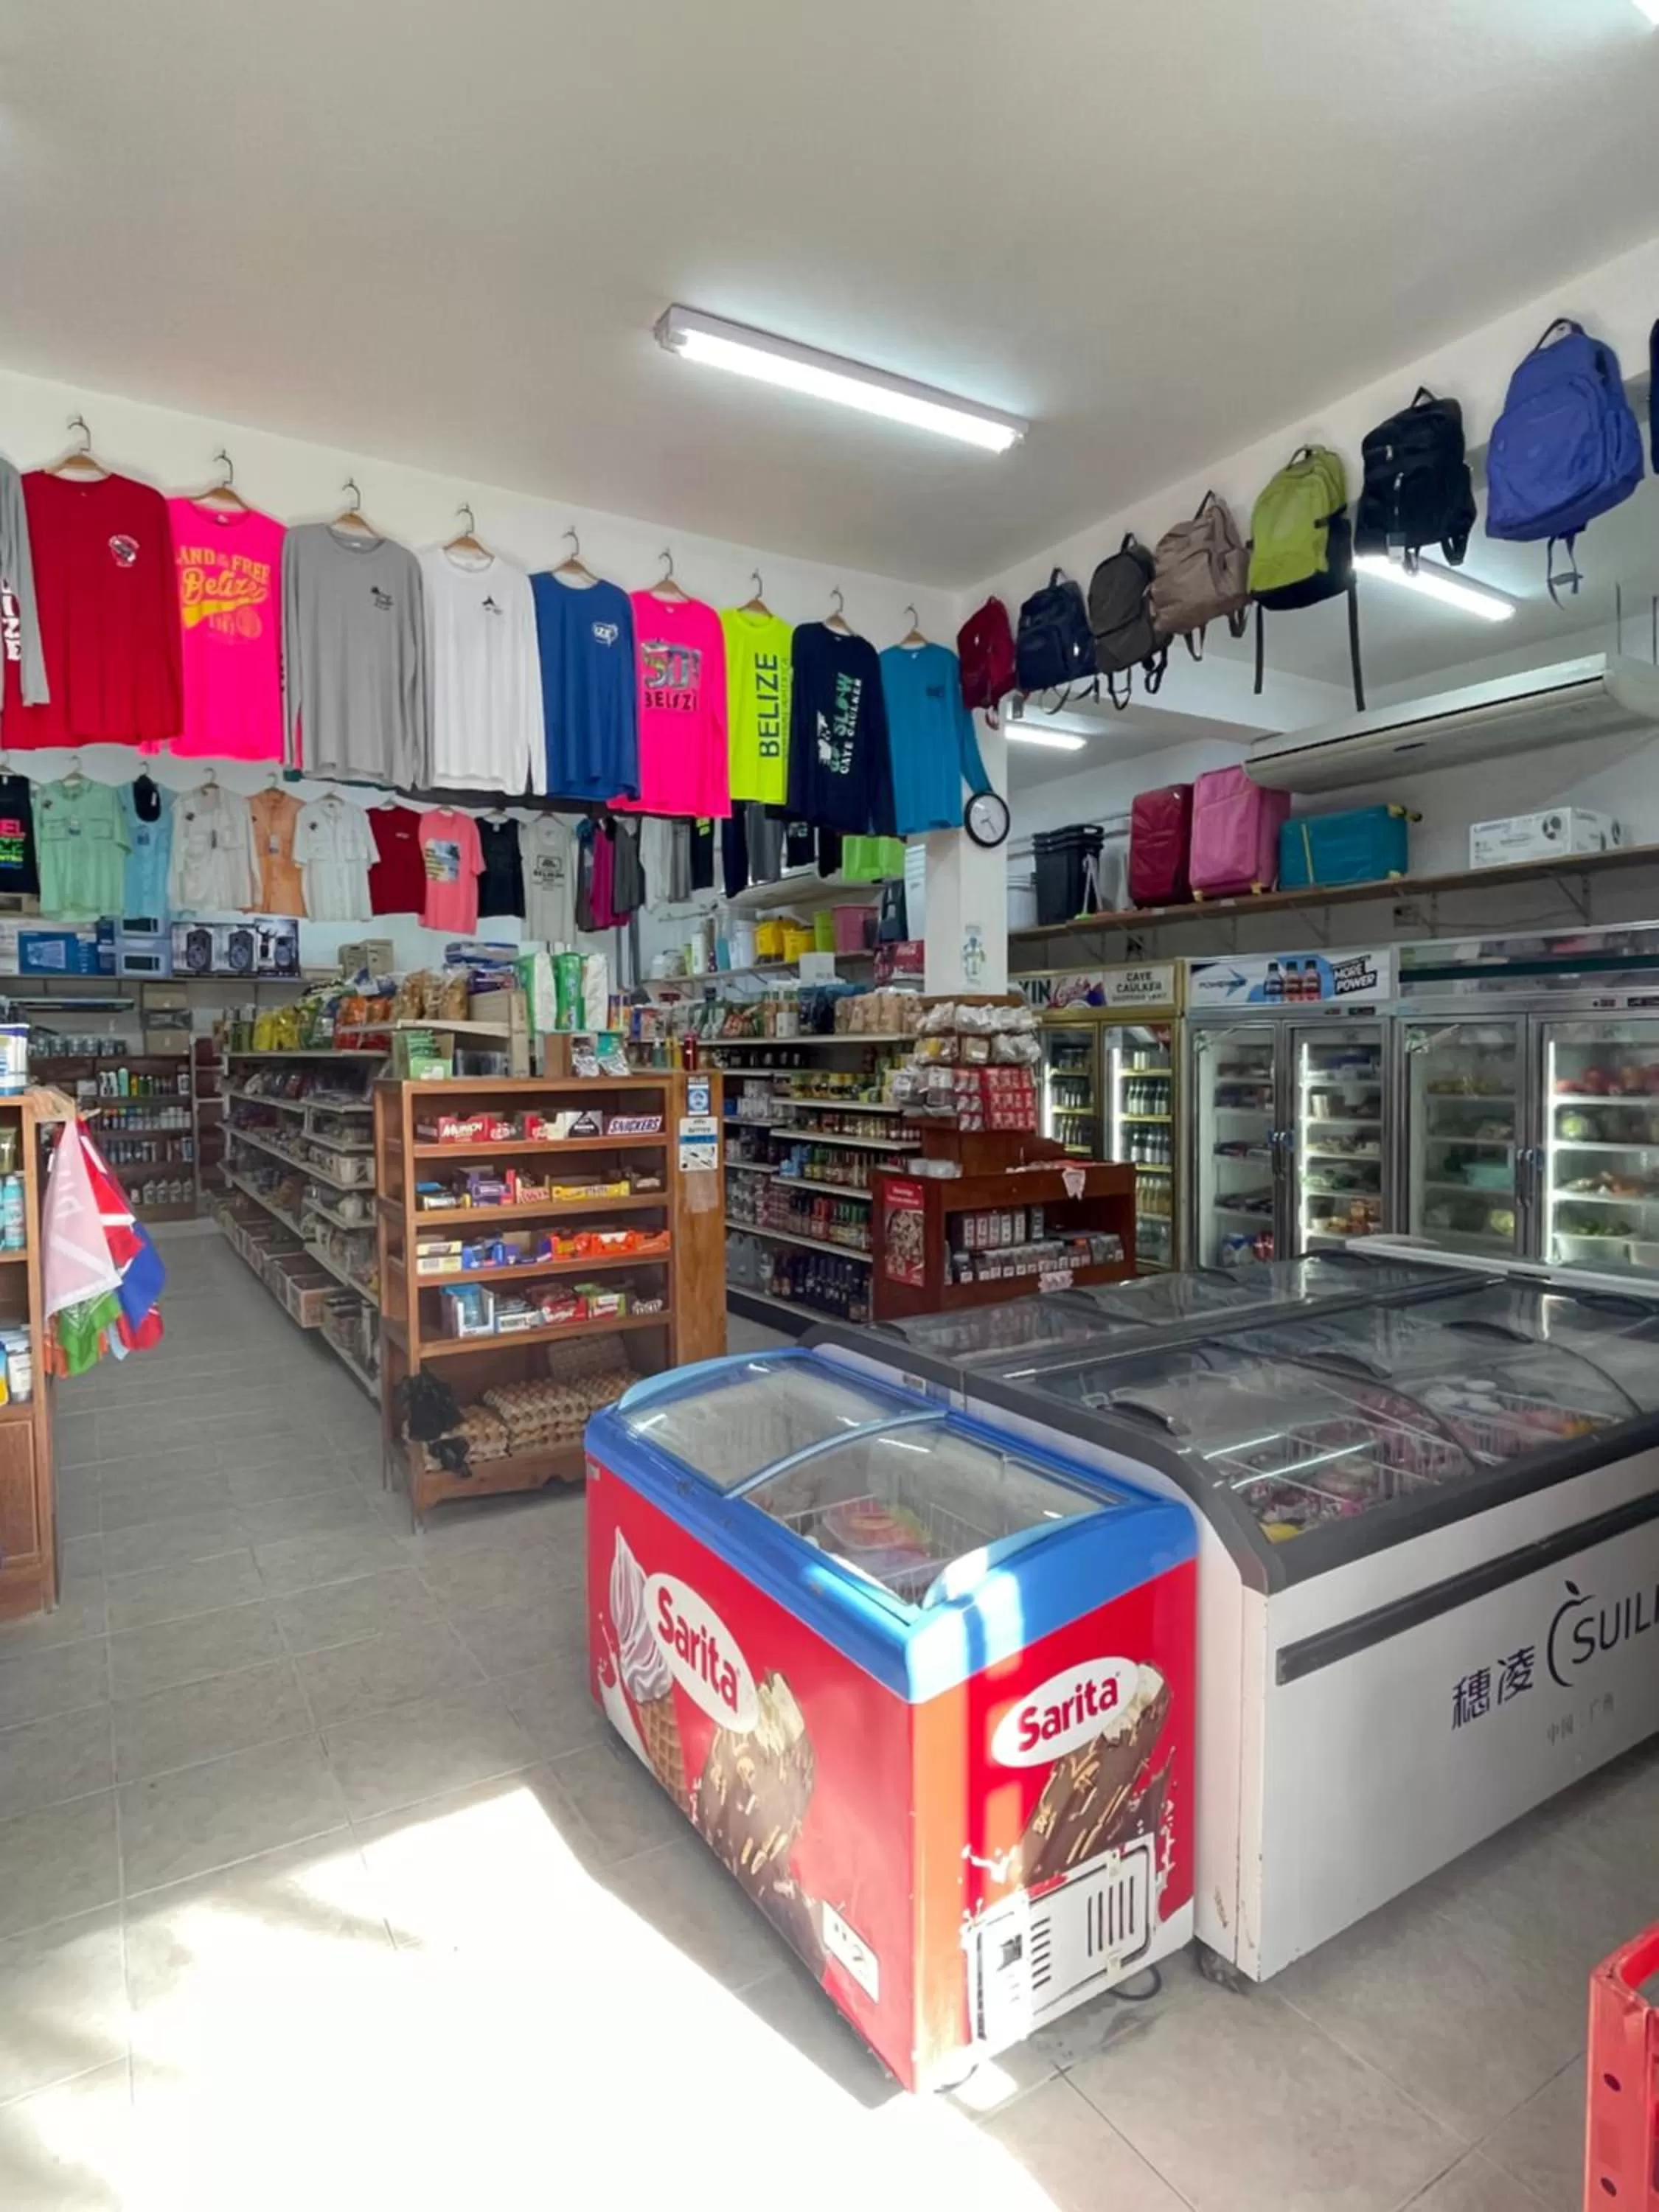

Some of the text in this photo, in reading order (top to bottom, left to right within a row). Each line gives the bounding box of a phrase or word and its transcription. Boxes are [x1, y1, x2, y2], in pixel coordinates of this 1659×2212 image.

[184, 567, 268, 606] Belize
[755, 653, 779, 758] BELIZE
[839, 742, 854, 774] CAYE
[1126, 971, 1152, 982] CAYE
[1335, 962, 1364, 981] MORE
[1336, 973, 1377, 993] POWER
[658, 1586, 738, 1714] Sarita
[1451, 1644, 1535, 1731] 穗凌
[1018, 1677, 1119, 1752] Sarita
